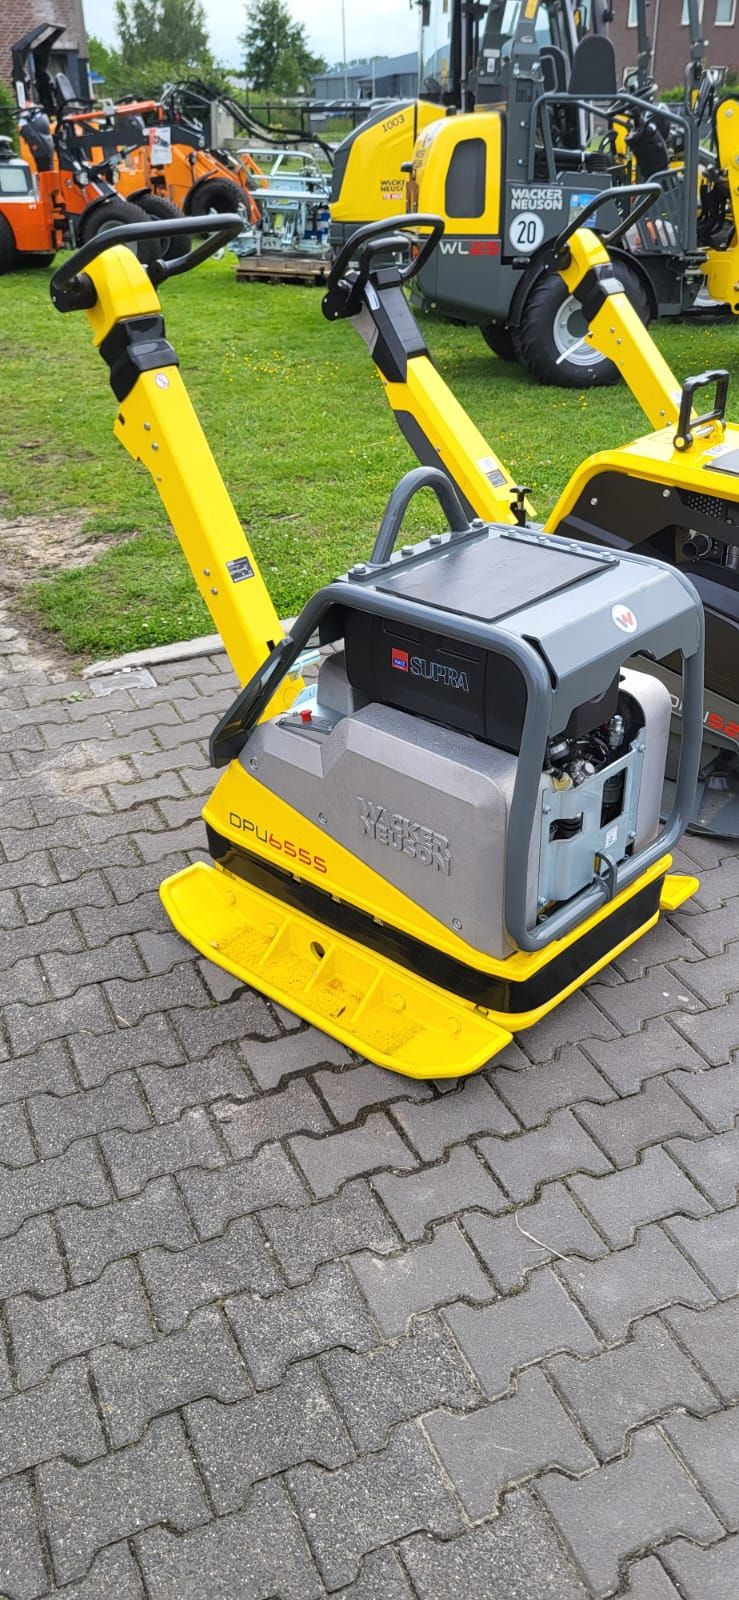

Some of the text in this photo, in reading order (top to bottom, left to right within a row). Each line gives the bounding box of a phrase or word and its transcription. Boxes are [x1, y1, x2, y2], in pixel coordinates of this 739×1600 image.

[382, 114, 405, 133] 1003
[511, 188, 562, 200] WACKER
[511, 199, 562, 210] NEUSON
[517, 220, 537, 244] 20
[409, 656, 470, 692] SUPRA
[357, 796, 450, 850] WACKER
[229, 812, 328, 874] DPU6555
[359, 815, 451, 876] NEUSON
